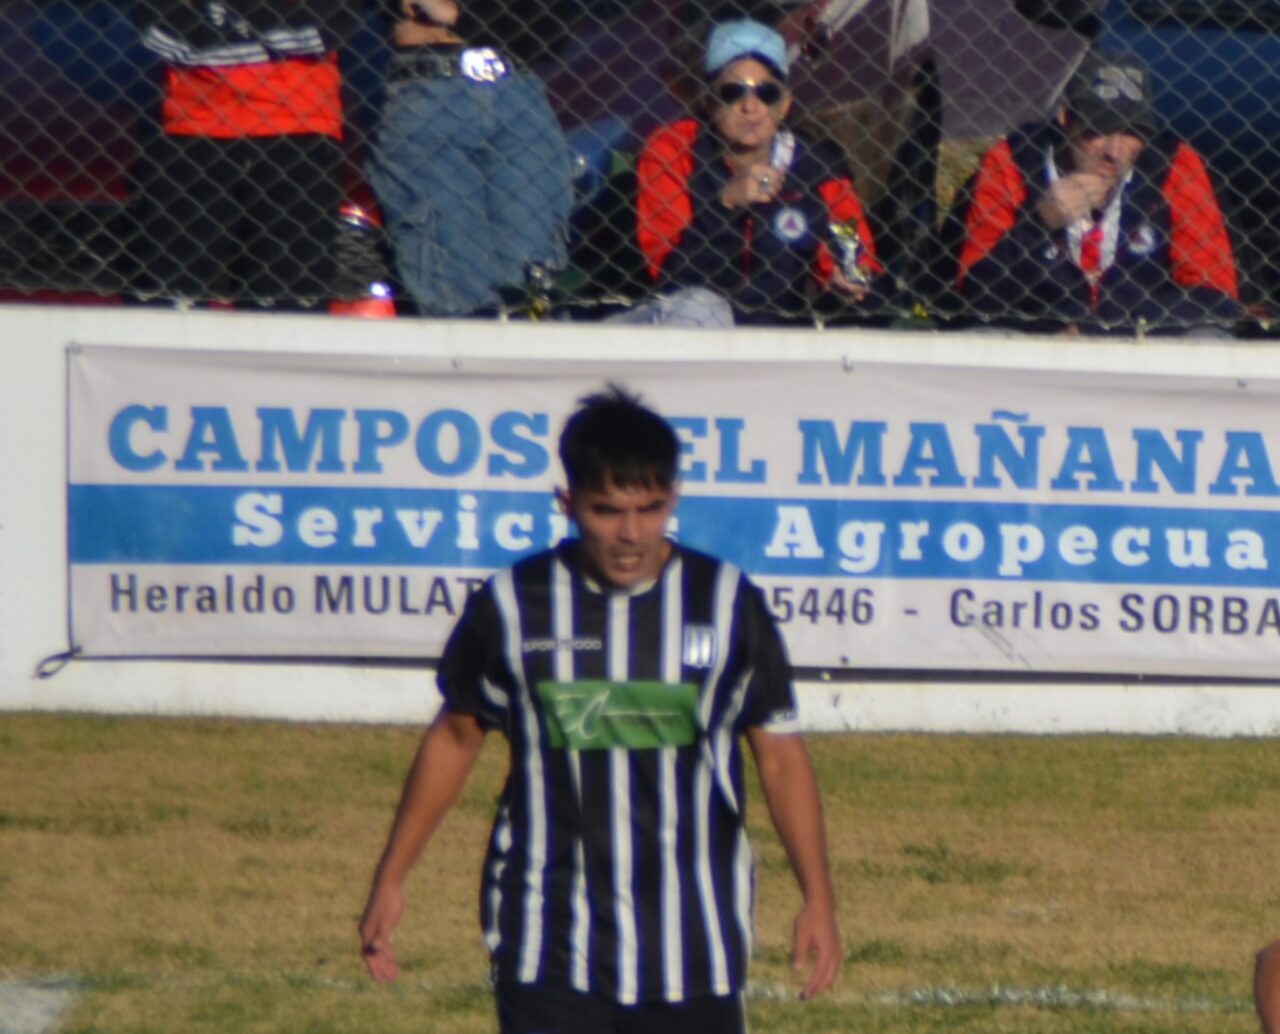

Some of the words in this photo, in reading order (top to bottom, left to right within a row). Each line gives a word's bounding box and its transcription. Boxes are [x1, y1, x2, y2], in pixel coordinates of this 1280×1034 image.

[106, 403, 550, 479] CAMPOS
[667, 415, 767, 484] EL
[232, 491, 679, 552] Servici
[109, 571, 297, 614] Heraldo
[772, 586, 875, 626] 5446
[948, 587, 1101, 634] Carlos
